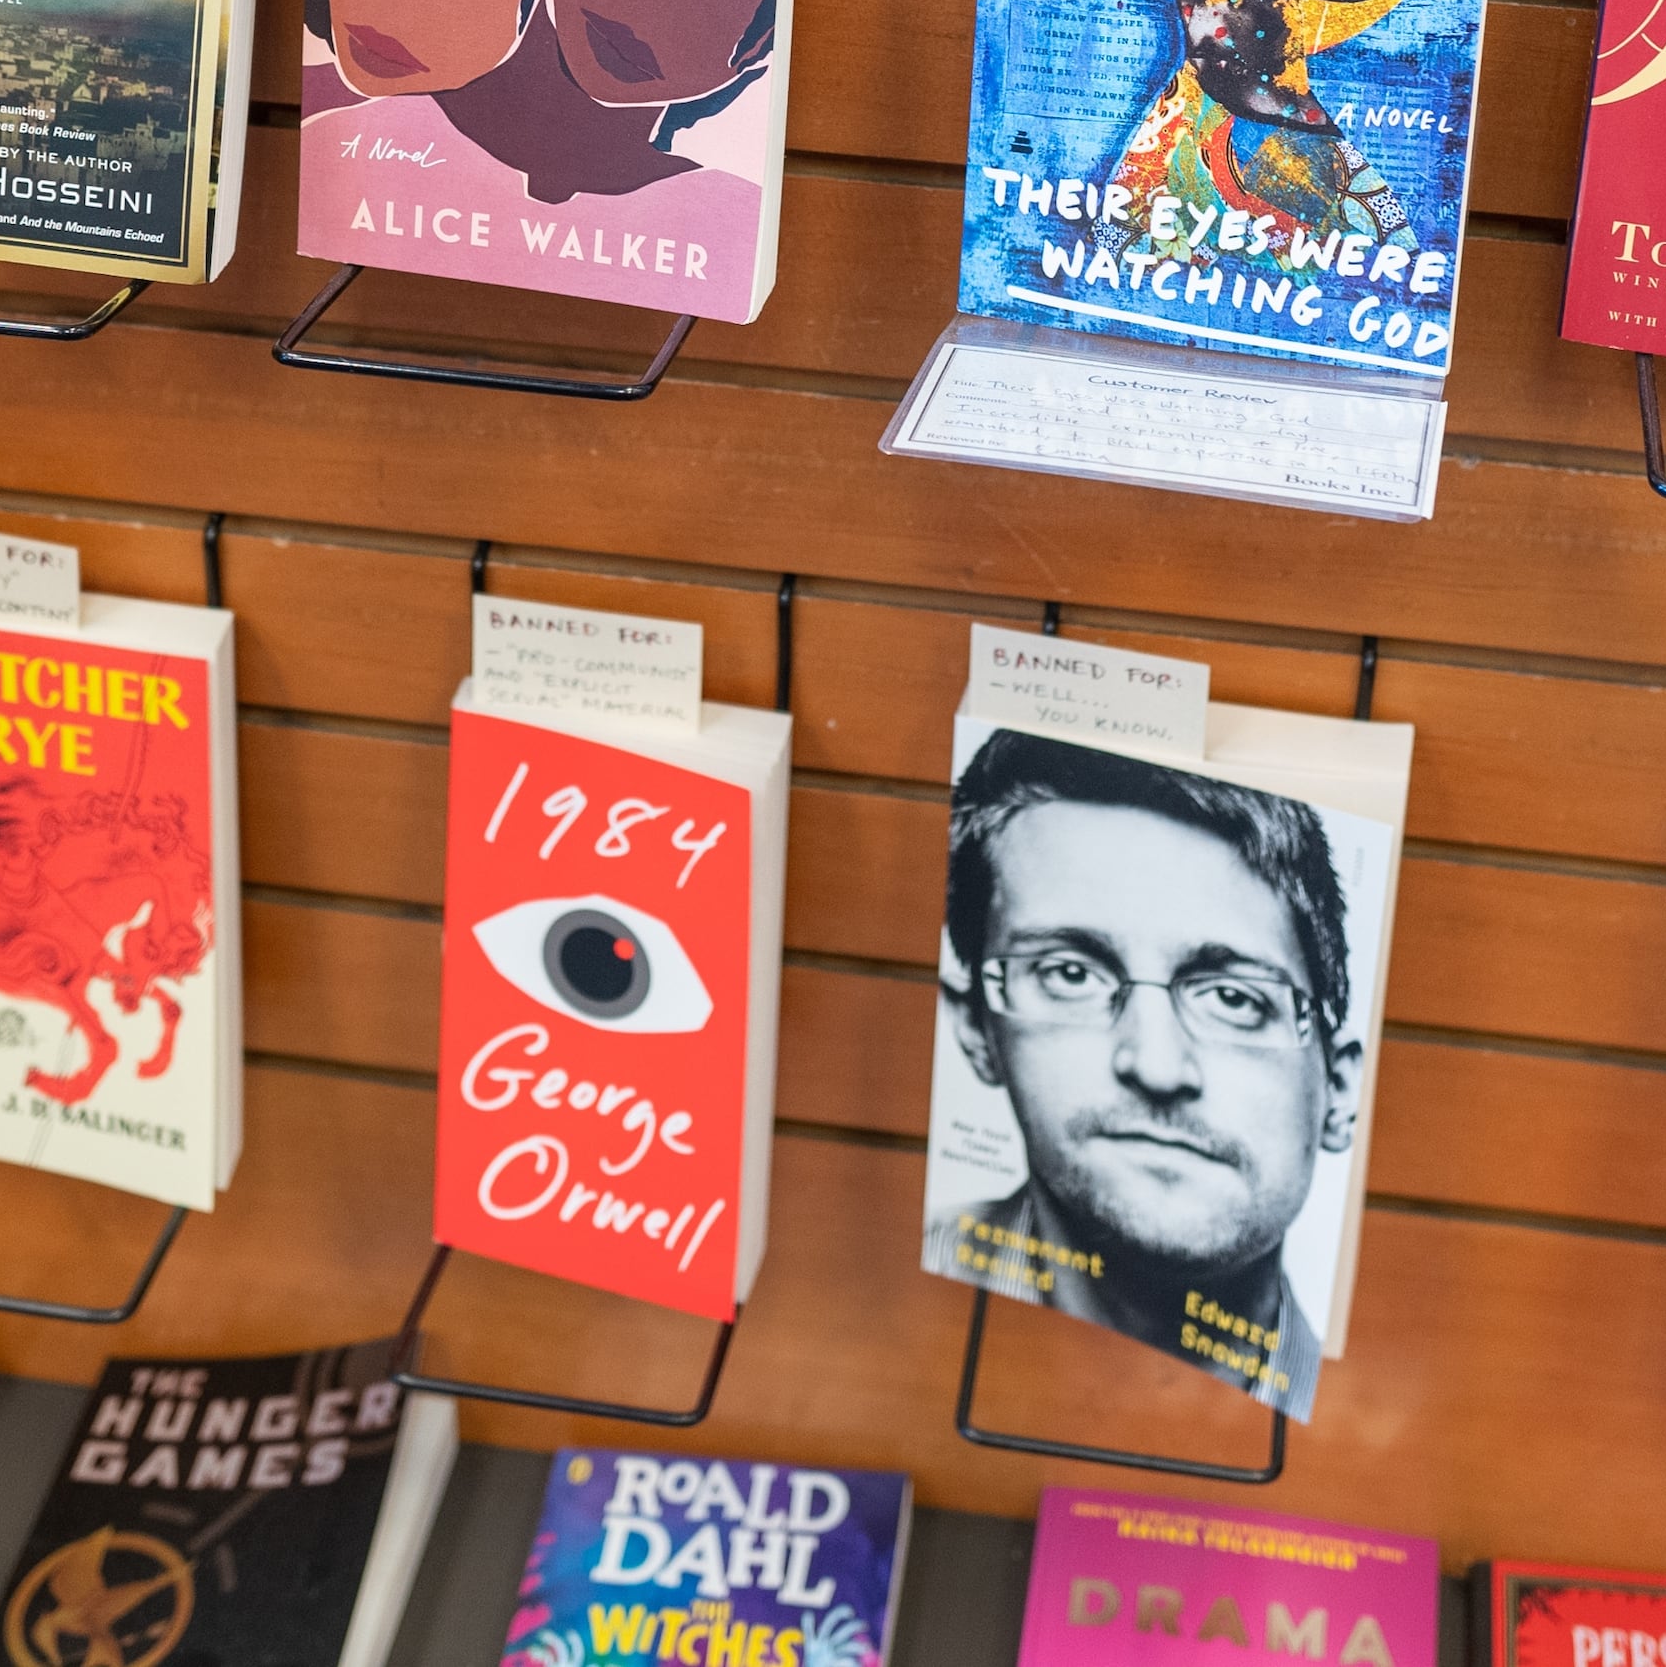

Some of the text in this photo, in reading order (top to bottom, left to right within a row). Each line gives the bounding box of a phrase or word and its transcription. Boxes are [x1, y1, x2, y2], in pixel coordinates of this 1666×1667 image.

[341, 134, 446, 168] A Novel
[1333, 105, 1453, 134] A NOVEL
[350, 198, 709, 281] ALICE WALKER
[982, 166, 1447, 296] THEIR EYES WERE
[1041, 238, 1449, 359] WATCHING GOD
[1285, 472, 1350, 495] Books
[484, 761, 726, 889] 1984
[460, 1022, 696, 1175] George
[476, 1134, 726, 1271] Orwell
[90, 1381, 399, 1442] HUNGER
[69, 1438, 350, 1490] GAMES
[605, 1456, 851, 1534] ROALD
[590, 1516, 836, 1609] DAHL
[588, 1603, 804, 1667] WITCHES
[1067, 1577, 1393, 1666] DRAMA
